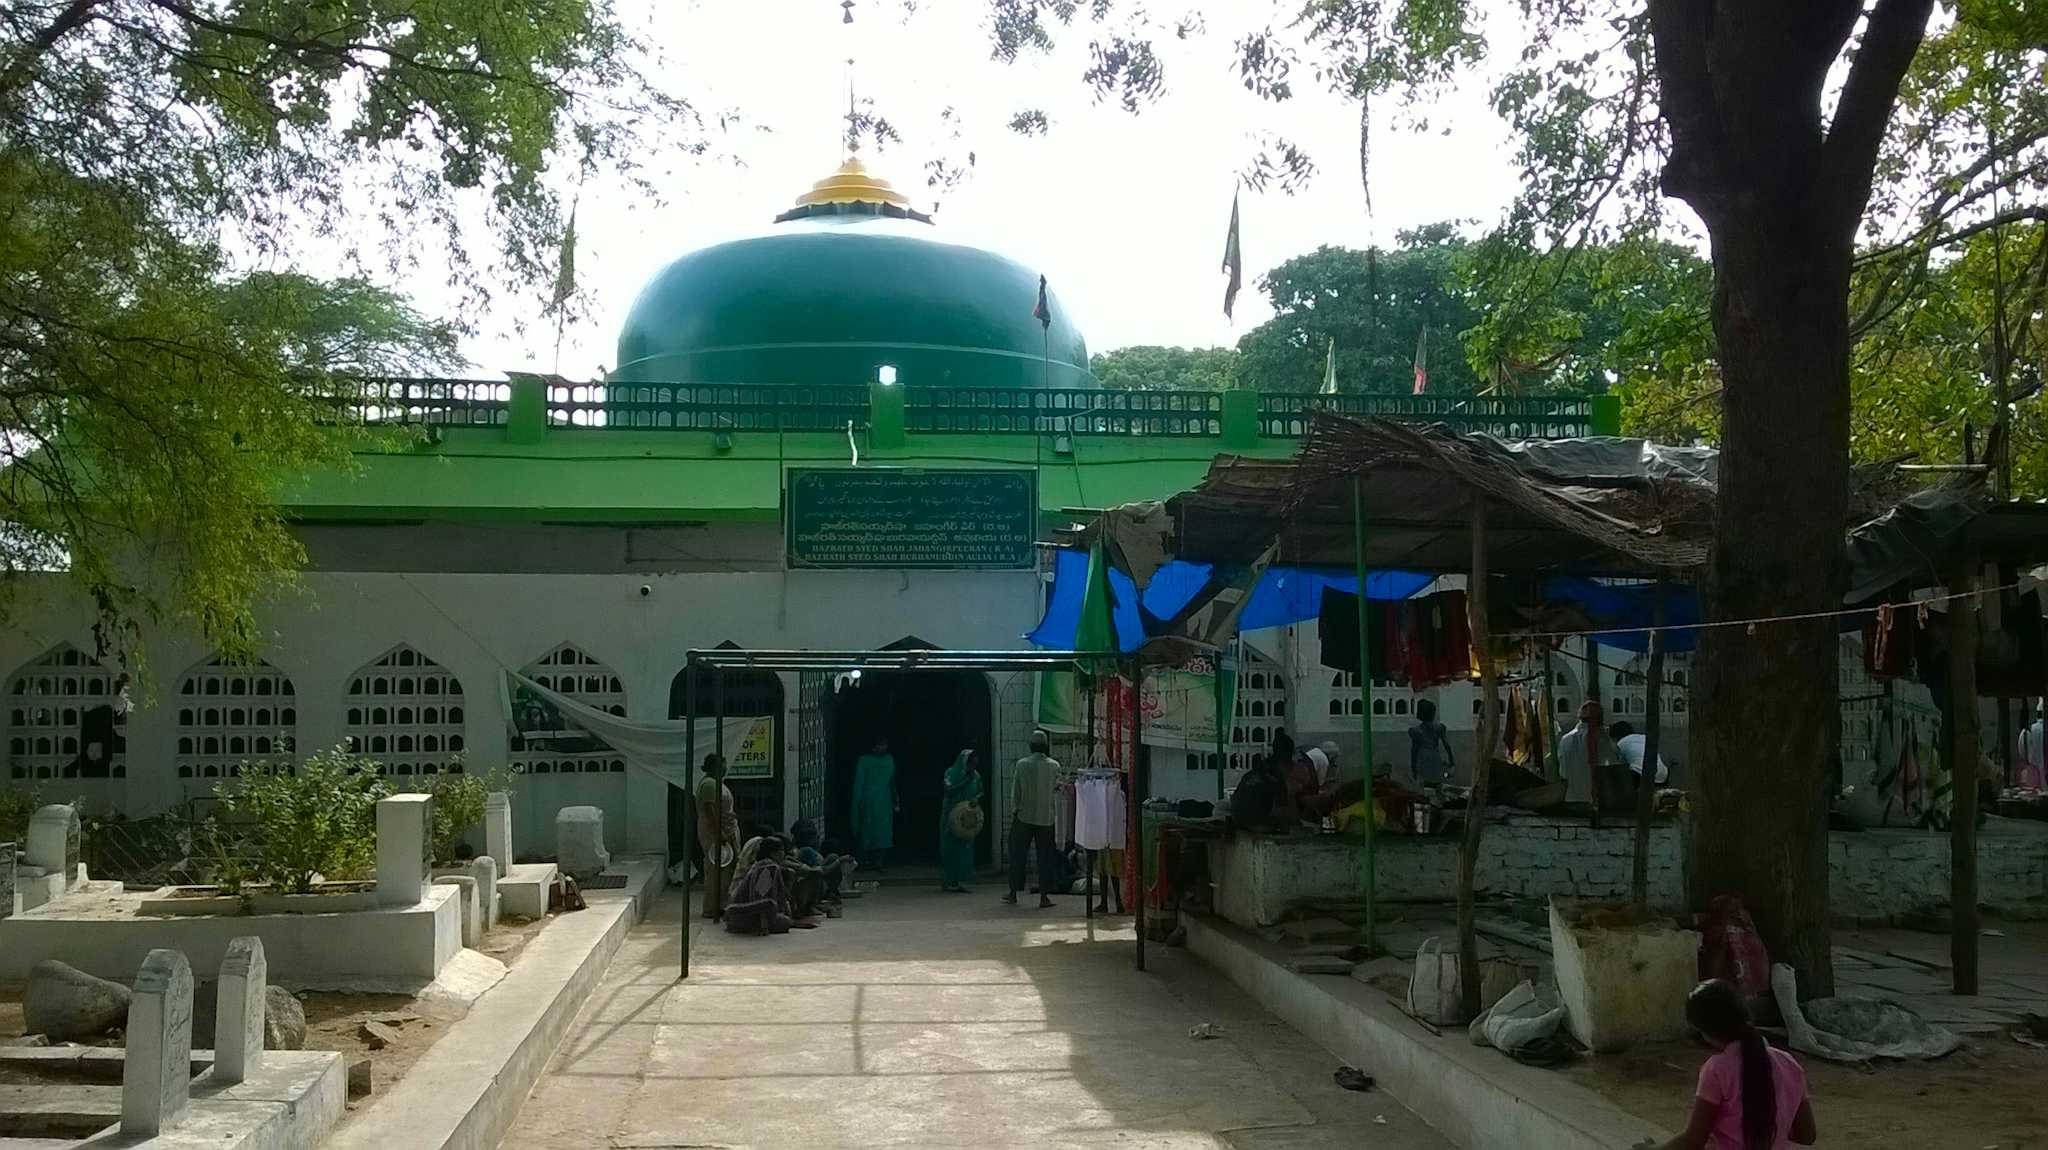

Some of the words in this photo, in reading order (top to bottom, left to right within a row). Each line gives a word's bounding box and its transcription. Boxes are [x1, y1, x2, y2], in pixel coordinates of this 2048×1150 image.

[855, 545, 879, 553] SYED
[880, 545, 905, 553] SHAH
[805, 553, 846, 561] HAZRATH
[848, 553, 871, 561] SYED
[873, 553, 898, 561] SHAH
